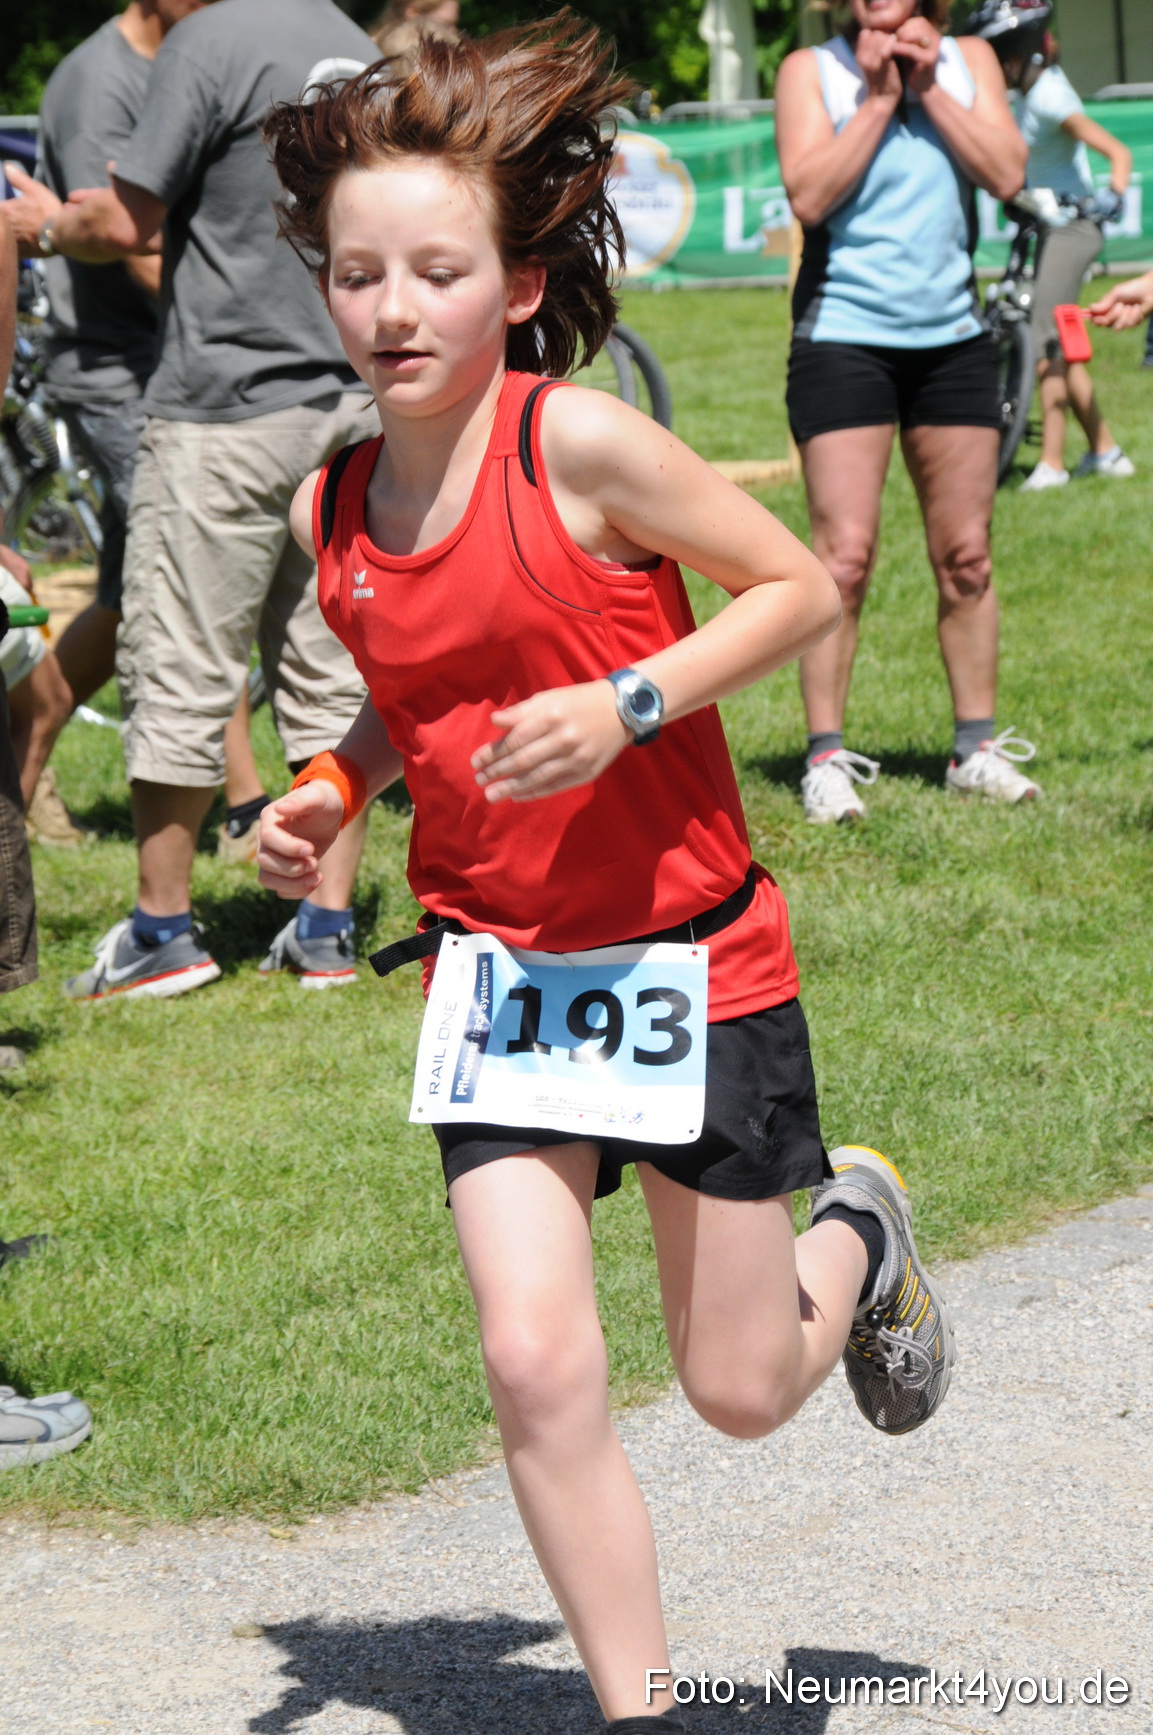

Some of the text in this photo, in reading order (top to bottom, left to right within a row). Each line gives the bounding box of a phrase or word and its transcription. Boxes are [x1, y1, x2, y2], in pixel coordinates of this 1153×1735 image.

[455, 960, 490, 1096] Pfleiderer track systems
[506, 984, 693, 1067] 193
